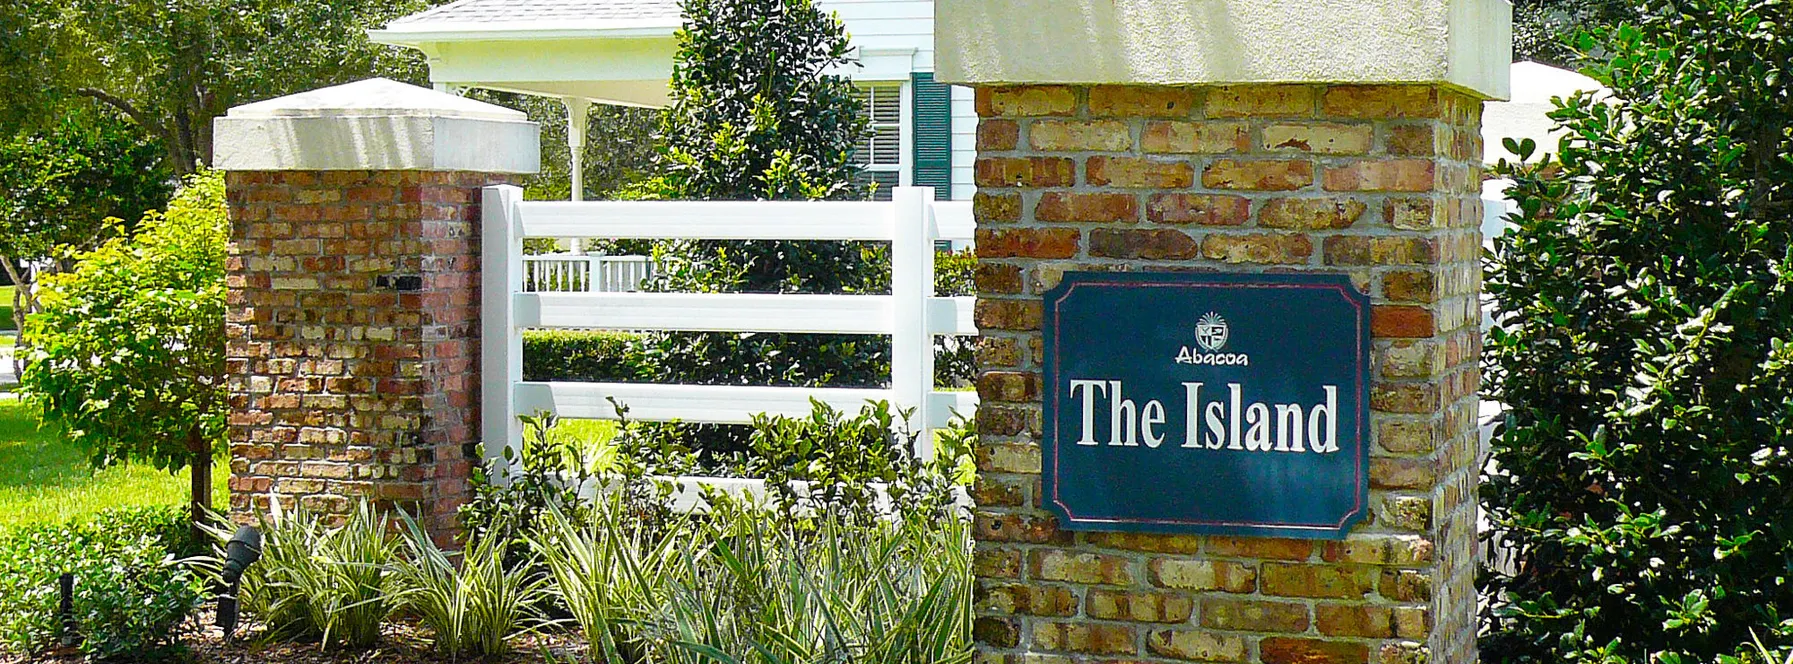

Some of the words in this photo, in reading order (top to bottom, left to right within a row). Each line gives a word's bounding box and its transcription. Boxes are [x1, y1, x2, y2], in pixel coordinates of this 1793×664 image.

[1175, 346, 1249, 366] Abacoa
[1069, 379, 1166, 448] The
[1180, 381, 1340, 453] Island
